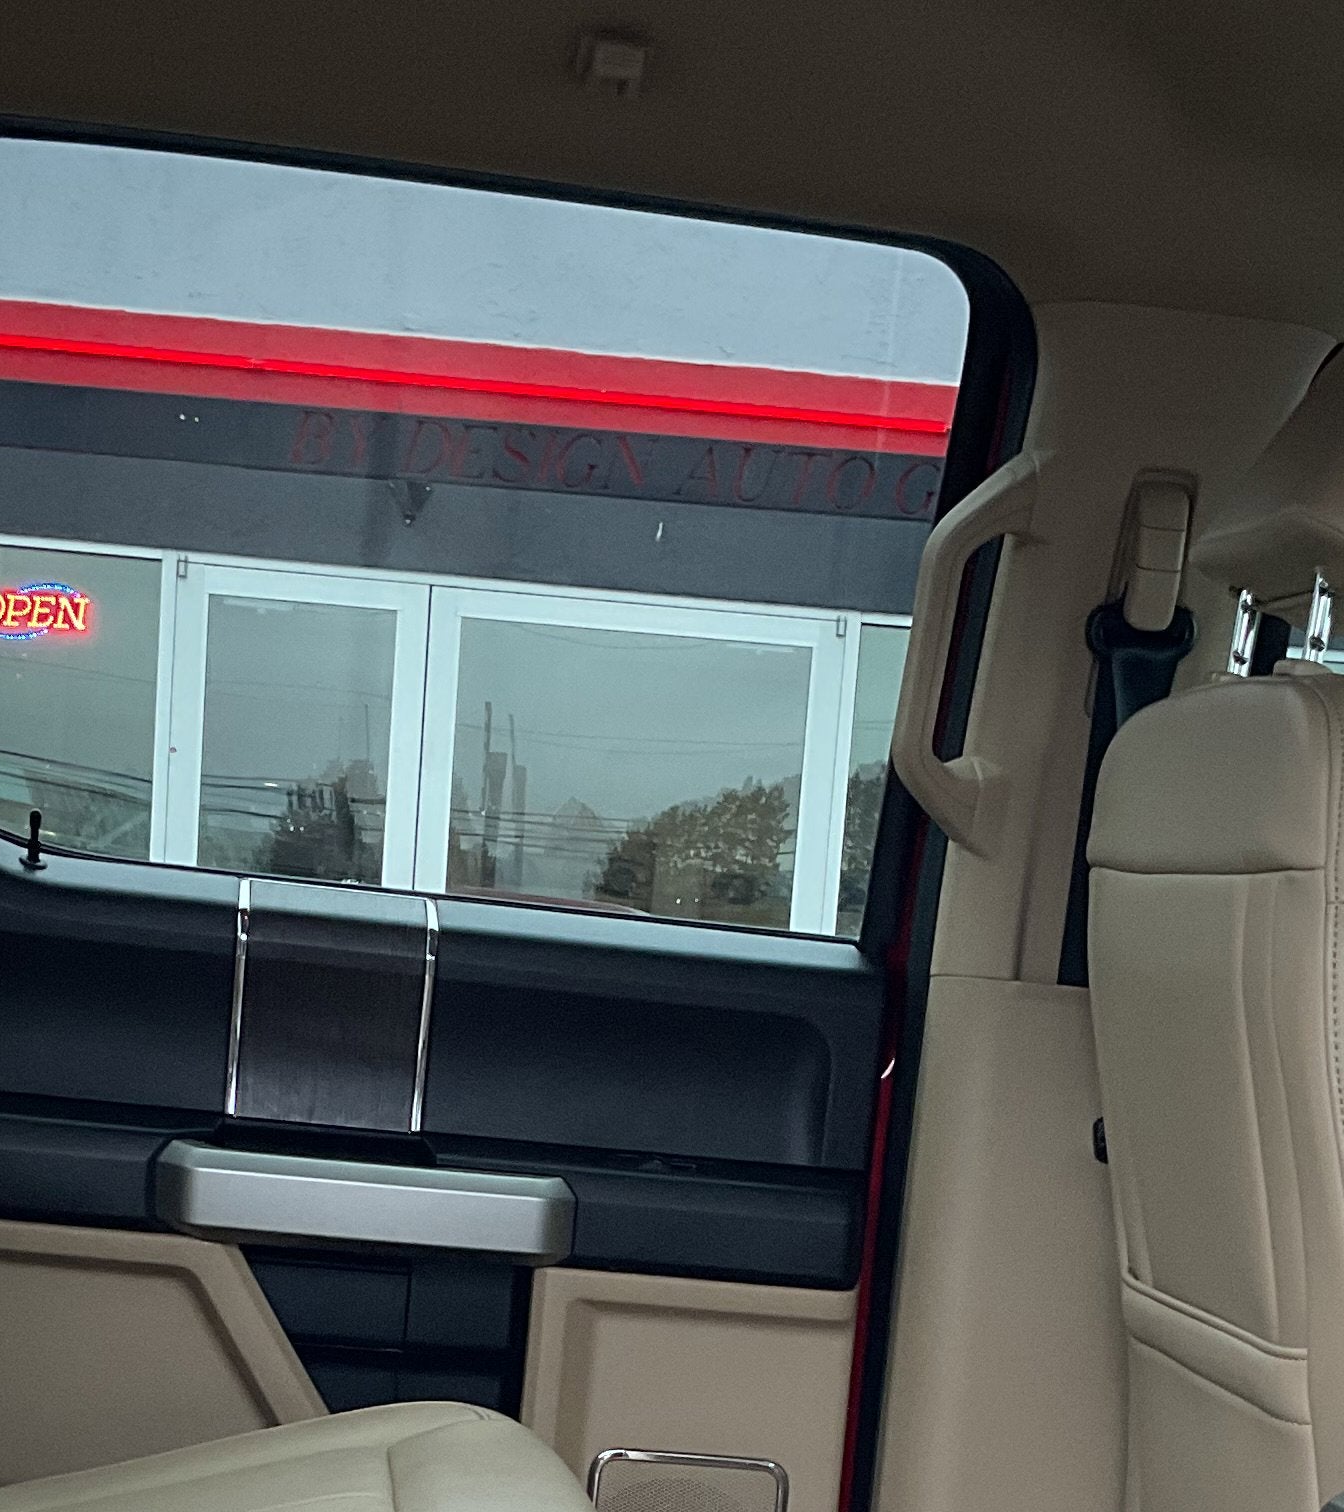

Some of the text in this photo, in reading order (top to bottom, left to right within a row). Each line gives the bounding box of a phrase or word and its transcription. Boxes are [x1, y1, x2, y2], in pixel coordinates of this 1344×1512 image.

[290, 409, 386, 468] BY
[400, 418, 661, 491] DESIGN
[669, 445, 878, 511] AUTO
